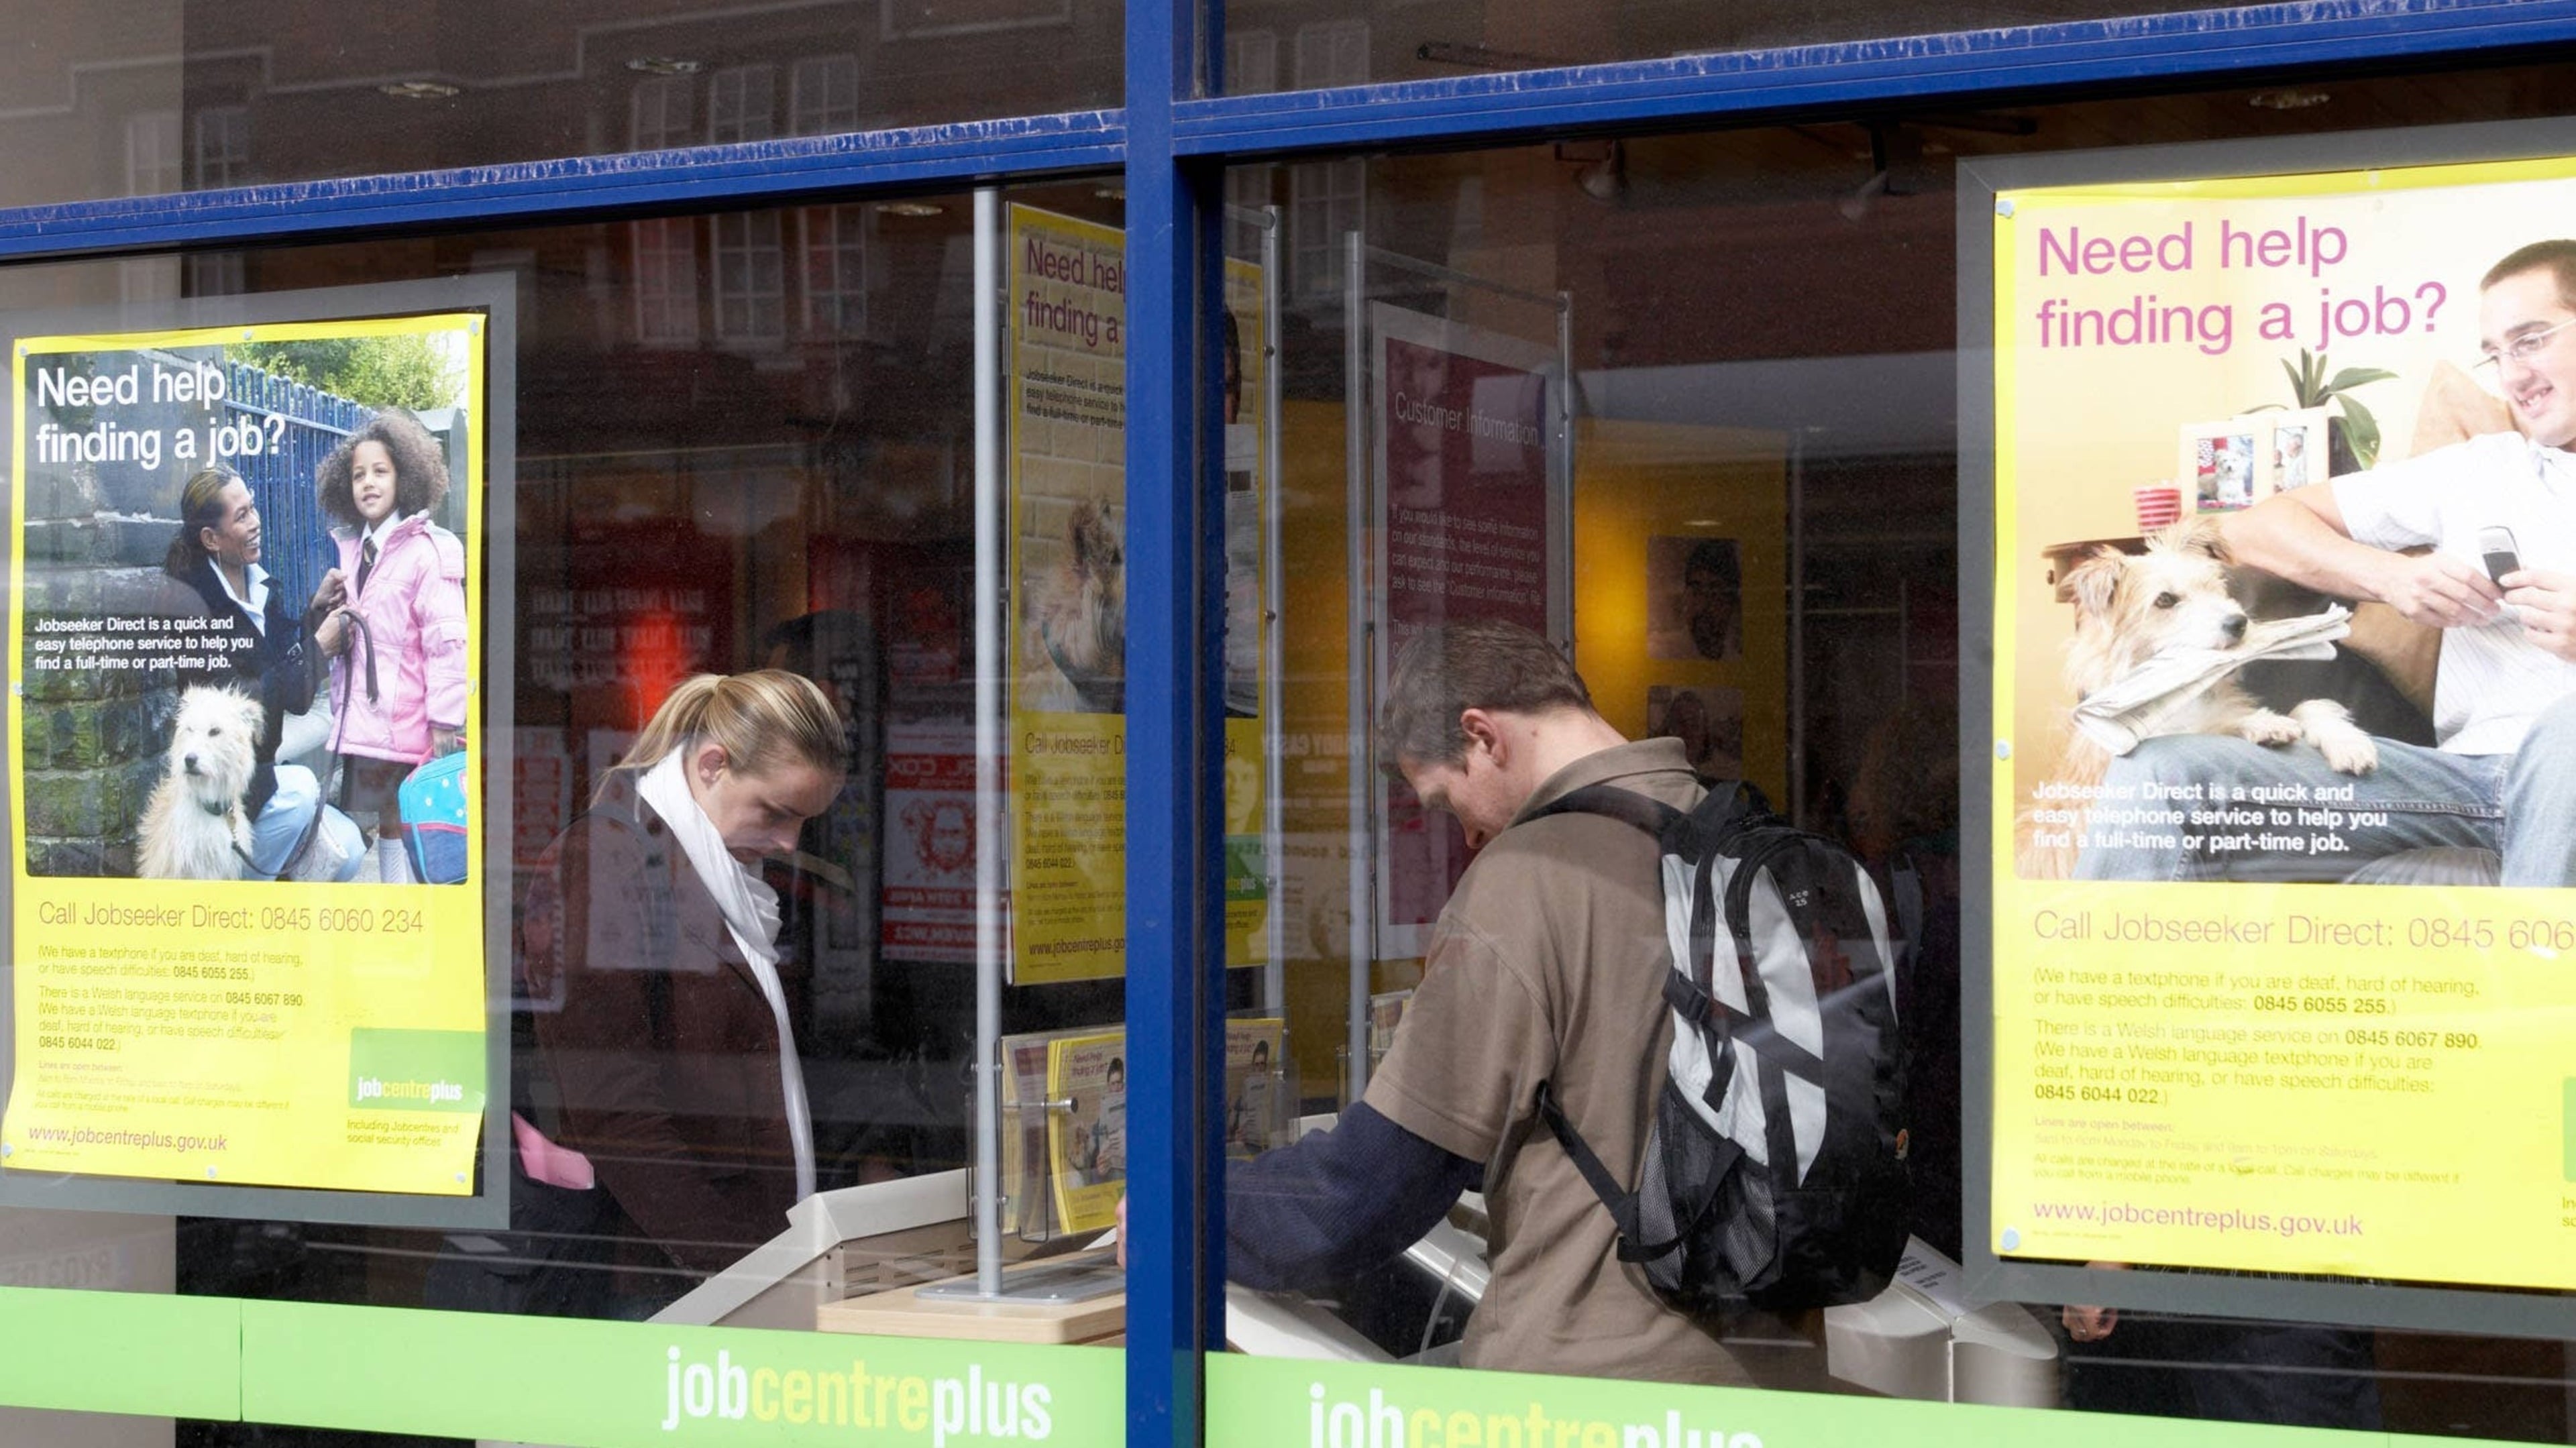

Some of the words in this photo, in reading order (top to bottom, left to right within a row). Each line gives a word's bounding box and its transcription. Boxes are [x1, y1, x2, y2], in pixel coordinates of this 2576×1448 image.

[2040, 221, 2192, 276] Need
[2221, 217, 2347, 277] help
[1027, 238, 1084, 284] Need
[1093, 254, 1126, 302] hel
[1026, 290, 1099, 347] finding
[1106, 315, 1118, 343] a
[2037, 295, 2232, 355] finding
[2259, 301, 2294, 339] a
[2315, 282, 2447, 351] job?
[38, 365, 138, 406] Need
[154, 364, 225, 410] help
[1395, 392, 1461, 431] Customer
[1466, 406, 1539, 447] Information
[36, 421, 161, 469] finding
[174, 428, 196, 457] a
[206, 414, 286, 467] job?
[1399, 508, 1413, 524] you
[35, 618, 103, 632] Jobseeker
[107, 618, 145, 630] Direct
[149, 617, 159, 630] is
[163, 620, 170, 630] a
[174, 616, 207, 632] quick
[211, 616, 233, 629] and
[35, 641, 66, 653] easy
[70, 637, 133, 653] telephone
[138, 636, 182, 649] service
[185, 636, 198, 649] to
[201, 636, 227, 651] help
[231, 638, 253, 651] you
[35, 657, 60, 669] find
[64, 659, 72, 669] a
[76, 656, 129, 669] full-time
[132, 659, 146, 669] or
[150, 655, 205, 671] part-time
[207, 655, 231, 671] job.
[1025, 732, 1047, 755] Call
[1051, 732, 1111, 755] Jobseeker
[2033, 781, 2137, 801] Jobseeker
[2142, 781, 2202, 800] Direct
[2210, 783, 2229, 801] is
[2233, 787, 2245, 800] a
[2251, 783, 2308, 804] quick
[2314, 783, 2354, 801] and
[2033, 810, 2078, 828] easy
[2084, 806, 2185, 830] telephone
[2191, 807, 2264, 825] service
[2270, 809, 2292, 825] to
[2298, 808, 2343, 830] help
[2349, 810, 2388, 830] you
[2033, 830, 2070, 848] find
[2077, 835, 2089, 848] a
[2093, 831, 2177, 849] full-time
[2182, 836, 2204, 849] or
[2210, 833, 2304, 853] part-time
[2310, 833, 2349, 854] job.
[40, 901, 76, 924] Call
[84, 903, 185, 927] Jobseeker
[193, 905, 253, 929] Direct:
[262, 907, 311, 931] 0845
[319, 908, 373, 932] 6060
[382, 909, 423, 933] 234
[2035, 910, 2090, 940] Call
[2104, 913, 2274, 943] Jobseeker
[2288, 915, 2392, 946] Direct:
[2408, 918, 2494, 948] 0845
[2509, 920, 2576, 950] 606
[173, 966, 199, 978] 0845
[201, 967, 226, 979] 6055
[229, 968, 254, 981] 255.)
[2034, 967, 2064, 985] (We
[2070, 969, 2107, 985] have
[2112, 972, 2123, 985] a
[2128, 972, 2210, 989] textphone
[2216, 972, 2224, 987] if
[2229, 977, 2260, 991] you
[2266, 977, 2292, 989] are
[2299, 975, 2339, 991] deaf,
[2347, 975, 2384, 991] hard
[2391, 977, 2407, 992] of
[2412, 978, 2479, 998] hearing,
[225, 992, 251, 1004] 0845
[254, 993, 280, 1005] 6067
[283, 994, 303, 1007] 890.
[2034, 991, 2050, 1004] or
[2055, 989, 2093, 1005] have
[2098, 993, 2157, 1008] speech
[2163, 994, 2245, 1010] difficulties:
[2254, 995, 2297, 1011] 0845
[2304, 997, 2347, 1013] 6055
[2354, 998, 2396, 1013] 255.)
[39, 1036, 64, 1048] 0845
[68, 1037, 93, 1049] 6044
[97, 1038, 120, 1050] 022.)
[2035, 1019, 2079, 1035] There
[2084, 1021, 2096, 1036] is
[2102, 1025, 2112, 1037] a
[2116, 1022, 2165, 1038] Welsh
[2172, 1025, 2247, 1044] language
[2253, 1030, 2312, 1044] service
[2318, 1032, 2339, 1044] on
[2345, 1029, 2389, 1046] 0845
[2396, 1031, 2438, 1047] 6067
[2445, 1033, 2481, 1049] 890.
[357, 1076, 463, 1104] jobcentreplus
[2035, 1084, 2075, 1100] 0845
[2081, 1086, 2121, 1101] 6044
[2128, 1089, 2167, 1106] 022.)
[29, 1125, 227, 1152] www.jobcentreplus.gov.uk
[347, 1119, 389, 1133] Including
[392, 1121, 440, 1133] Jobcentres
[347, 1135, 374, 1143] social
[376, 1136, 411, 1148] security
[413, 1136, 441, 1146] offices
[2034, 1201, 2363, 1237] www.jobcentreplus.gov.uk
[662, 1345, 1052, 1448] jobcentreplus
